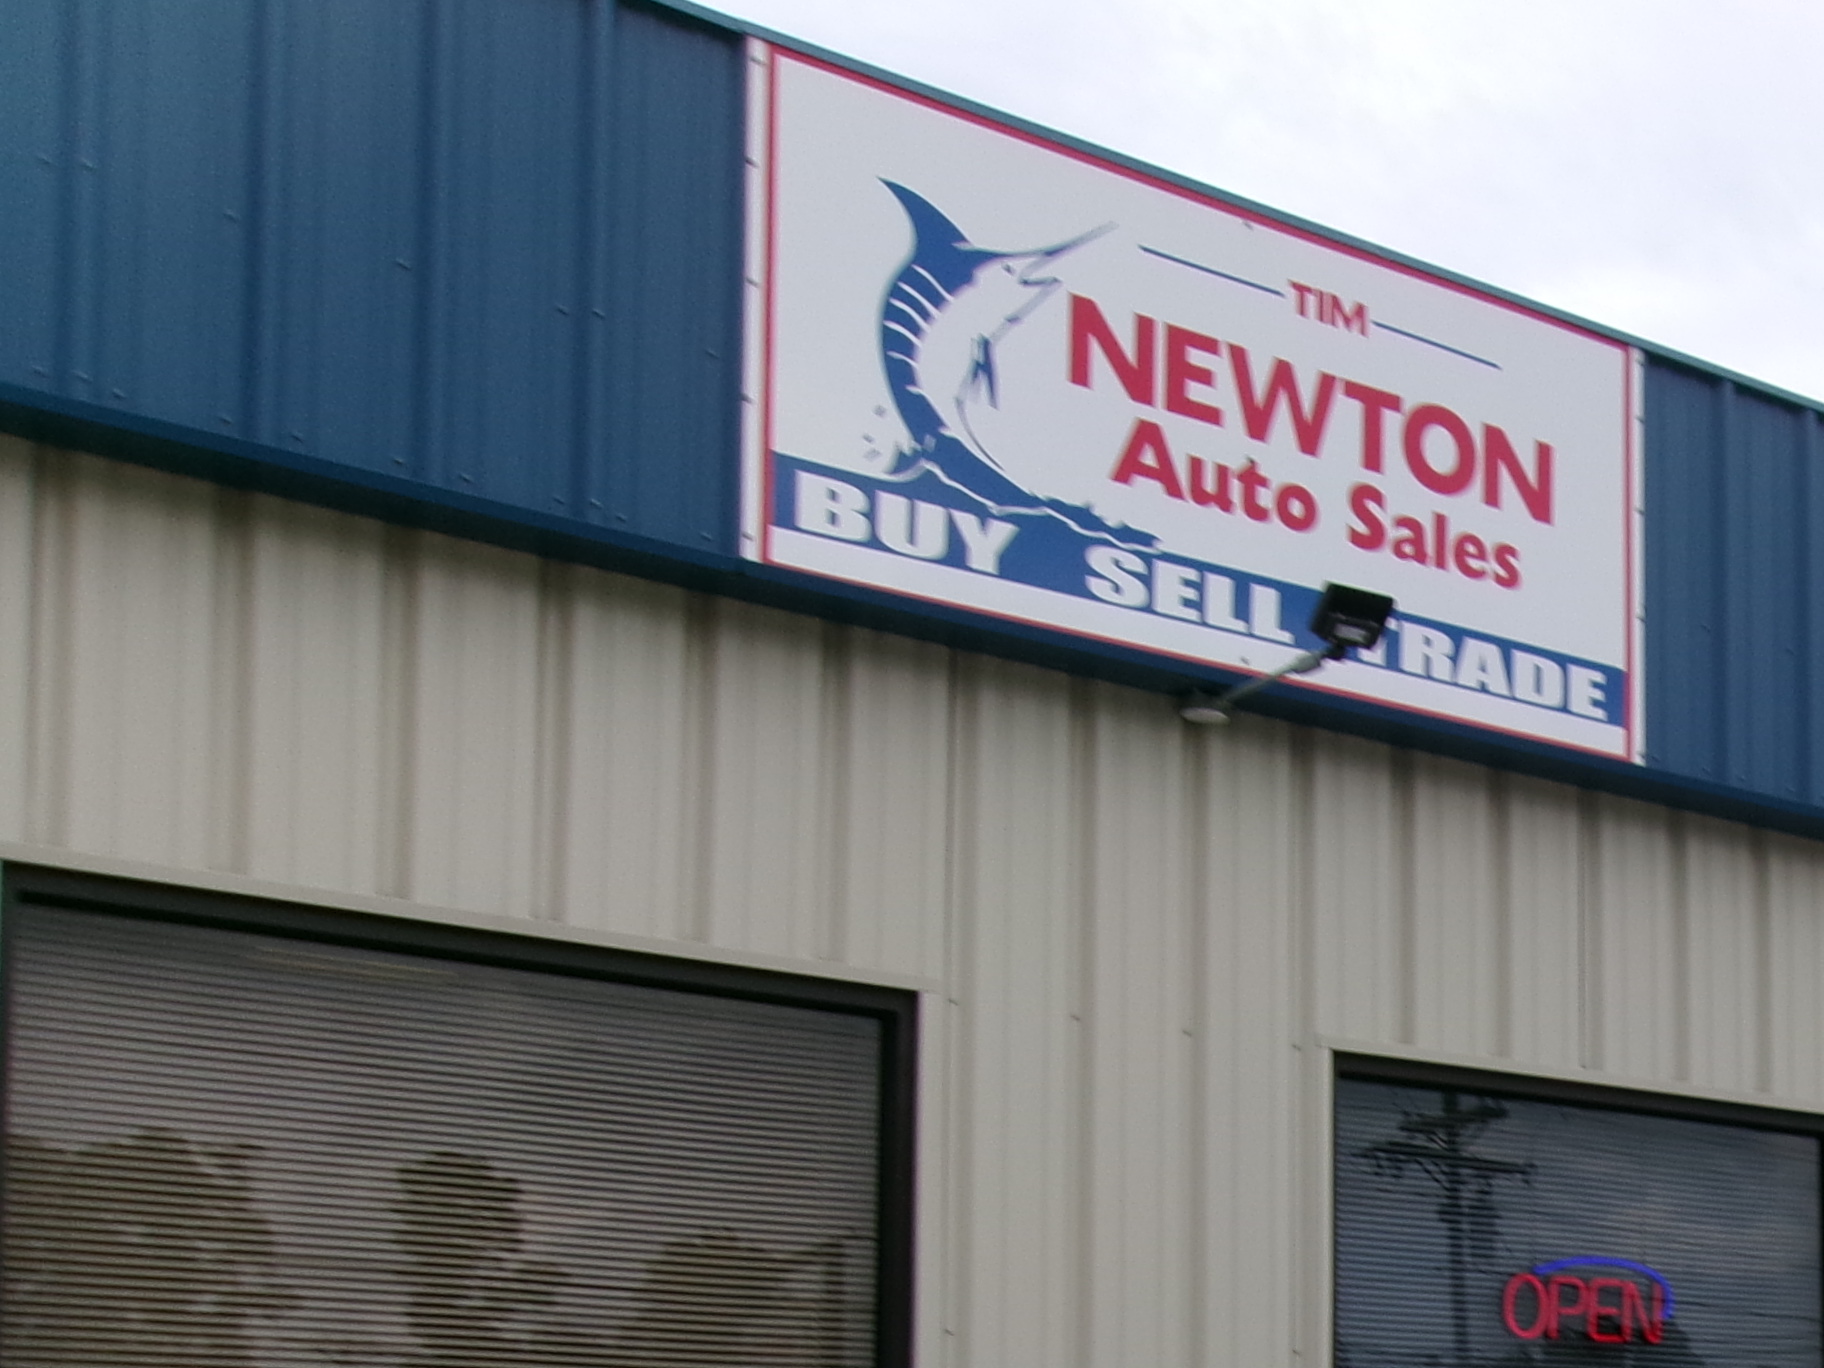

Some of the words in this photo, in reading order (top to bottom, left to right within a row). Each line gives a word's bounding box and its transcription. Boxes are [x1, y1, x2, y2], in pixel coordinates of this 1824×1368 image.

[1287, 279, 1369, 337] TIM
[1067, 291, 1555, 525] NEWTON
[794, 469, 1019, 575] BUY
[1084, 545, 1295, 645] SELL
[1110, 416, 1319, 532] Auto
[1346, 482, 1522, 589] Sales
[1502, 1271, 1665, 1345] OPEN
